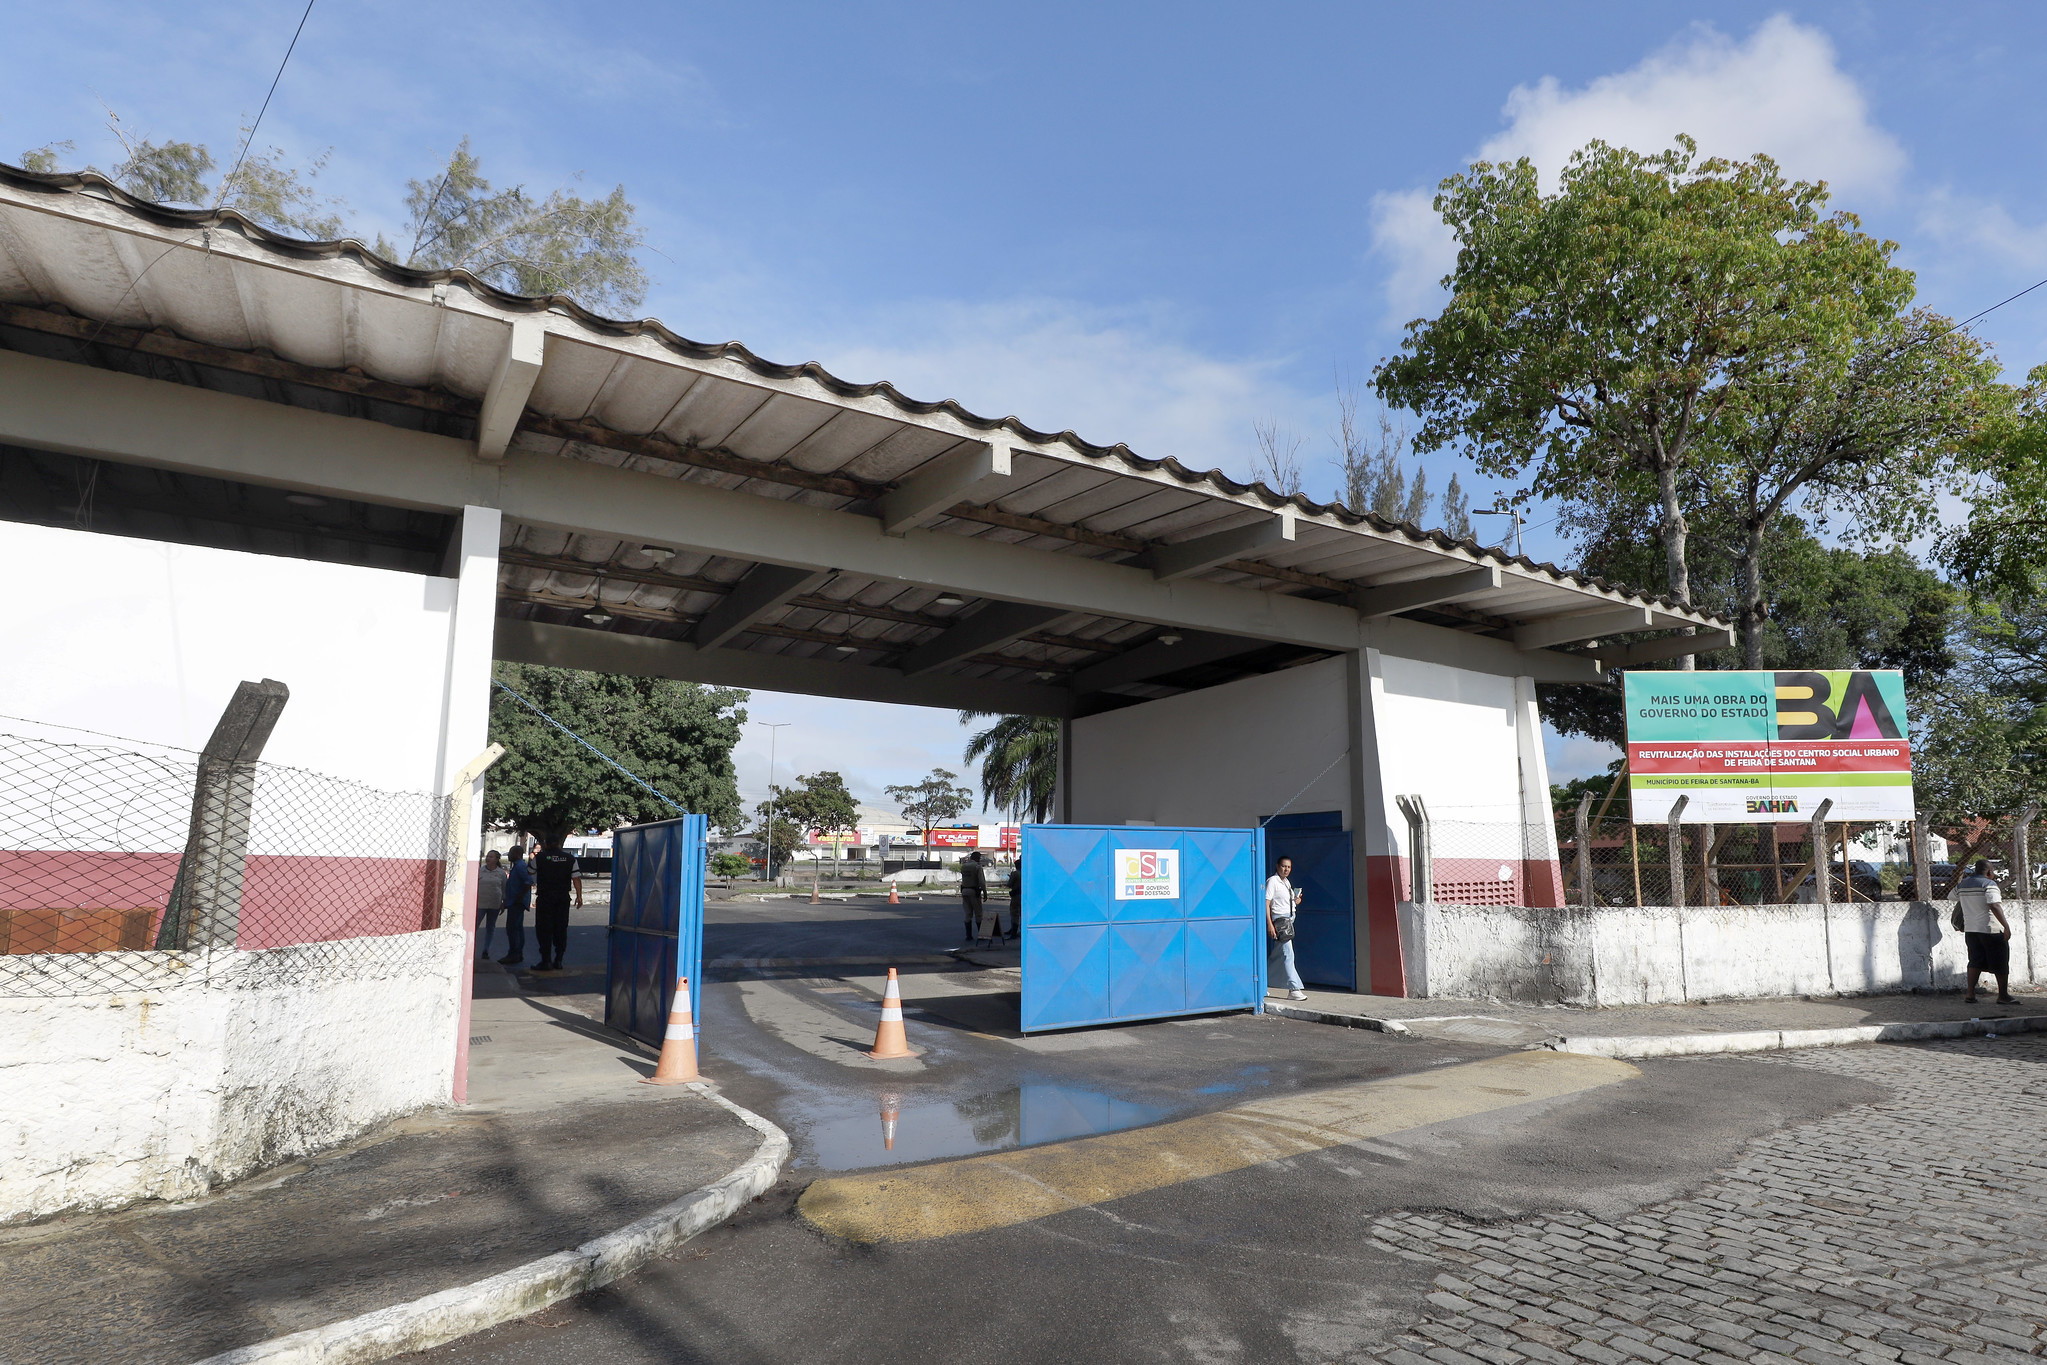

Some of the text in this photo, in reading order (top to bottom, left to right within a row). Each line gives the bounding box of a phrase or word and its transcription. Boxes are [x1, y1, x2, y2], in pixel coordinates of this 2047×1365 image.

[1651, 695, 1768, 705] MAIS UMA OBRA DO
[1774, 672, 1903, 740] BA
[1639, 708, 1769, 718] GOVERNO DO ESTADO
[1639, 748, 1900, 760] REVITALIZAÇÃO DAS INSTALAÇÕES DO CENTRO SOCIAL URBANO
[1724, 759, 1736, 767] DE
[1778, 758, 1817, 766] SANTANA
[1646, 777, 1679, 785] MUNICÍPIO
[1746, 800, 1798, 813] BAHIA
[1126, 854, 1169, 877] CSU
